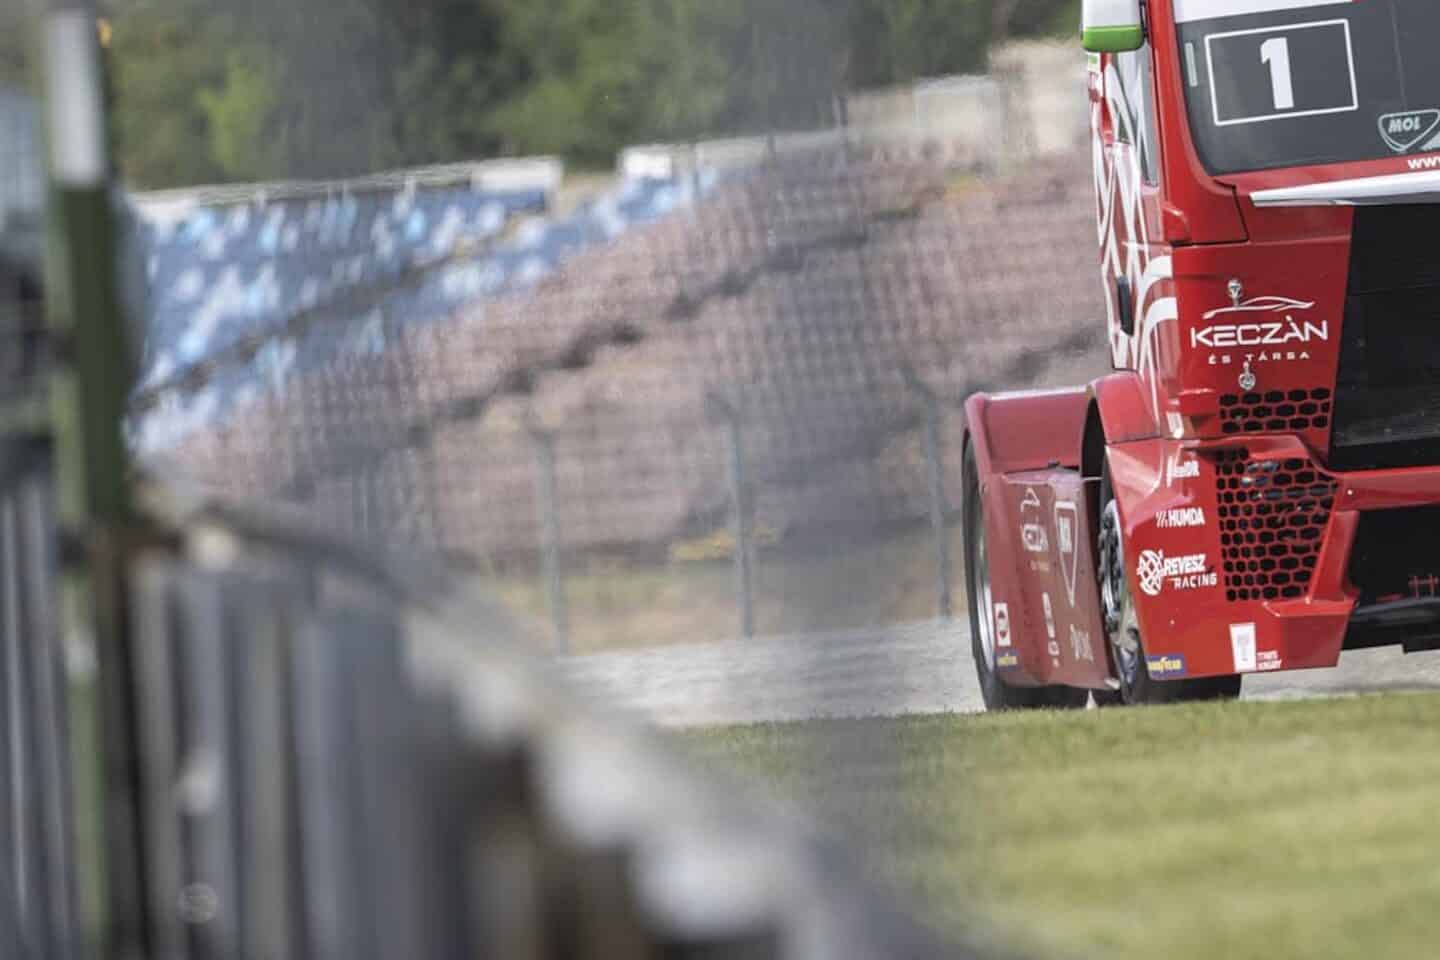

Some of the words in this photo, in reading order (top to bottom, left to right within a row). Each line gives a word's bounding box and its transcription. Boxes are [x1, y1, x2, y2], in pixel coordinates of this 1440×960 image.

[1260, 38, 1294, 110] 1
[1388, 115, 1421, 133] MOL
[1173, 573, 1217, 589] RACING
